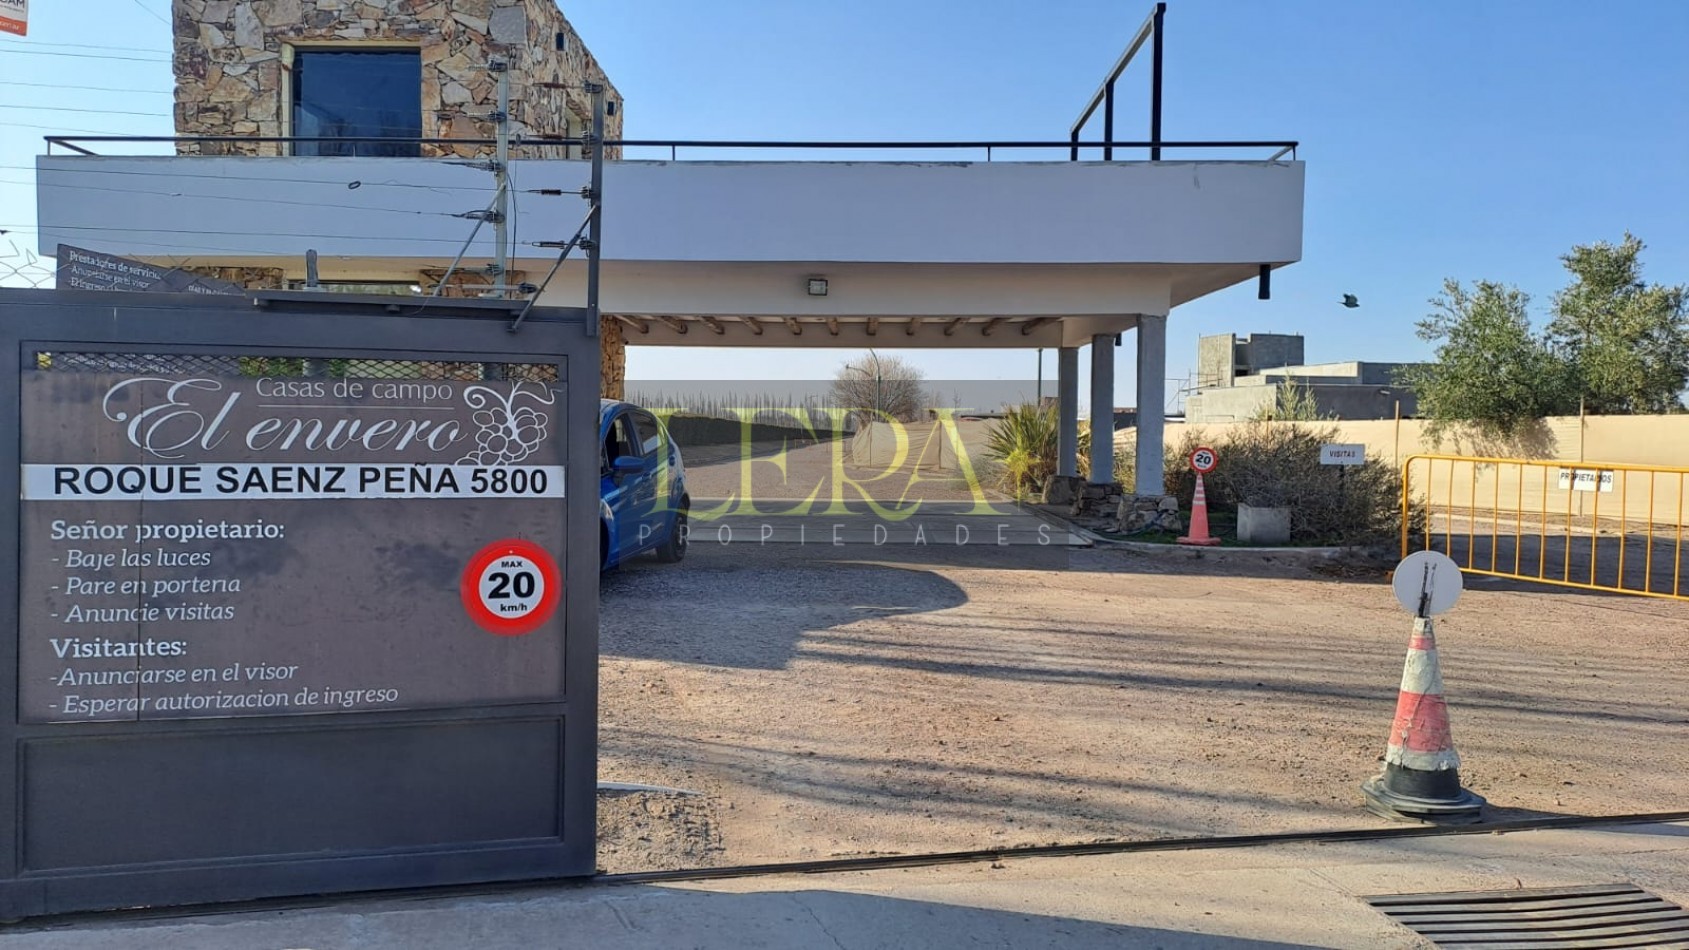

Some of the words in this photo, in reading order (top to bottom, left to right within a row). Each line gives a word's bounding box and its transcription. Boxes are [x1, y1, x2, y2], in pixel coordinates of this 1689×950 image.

[256, 377, 325, 398] Casas
[333, 378, 363, 398] de
[372, 384, 453, 405] campo
[103, 376, 241, 459] El
[245, 415, 469, 452] envero
[1195, 453, 1212, 465] 20
[54, 465, 202, 495] ROQUE
[215, 466, 347, 495] SAENZ
[359, 462, 459, 495] PEÑA
[470, 467, 548, 495] 5800
[1560, 472, 1612, 483] PROPIETAOS
[51, 519, 128, 540] Señor
[135, 518, 285, 543] propietario:
[64, 549, 116, 571] Baje
[120, 548, 152, 568] las
[156, 548, 212, 567] luces
[64, 577, 116, 596] Pare
[120, 580, 148, 594] en
[487, 571, 536, 599] 20
[64, 604, 160, 623] Anuncie
[165, 603, 236, 621] visitas
[500, 603, 528, 612] km/h
[50, 638, 188, 659] Visitantes:
[191, 668, 216, 684] en
[222, 663, 240, 682] el
[244, 663, 299, 681] visor
[62, 694, 152, 717] Esperar
[155, 690, 290, 712] autorizacion
[294, 687, 319, 706] de
[323, 686, 399, 707] ingreso
